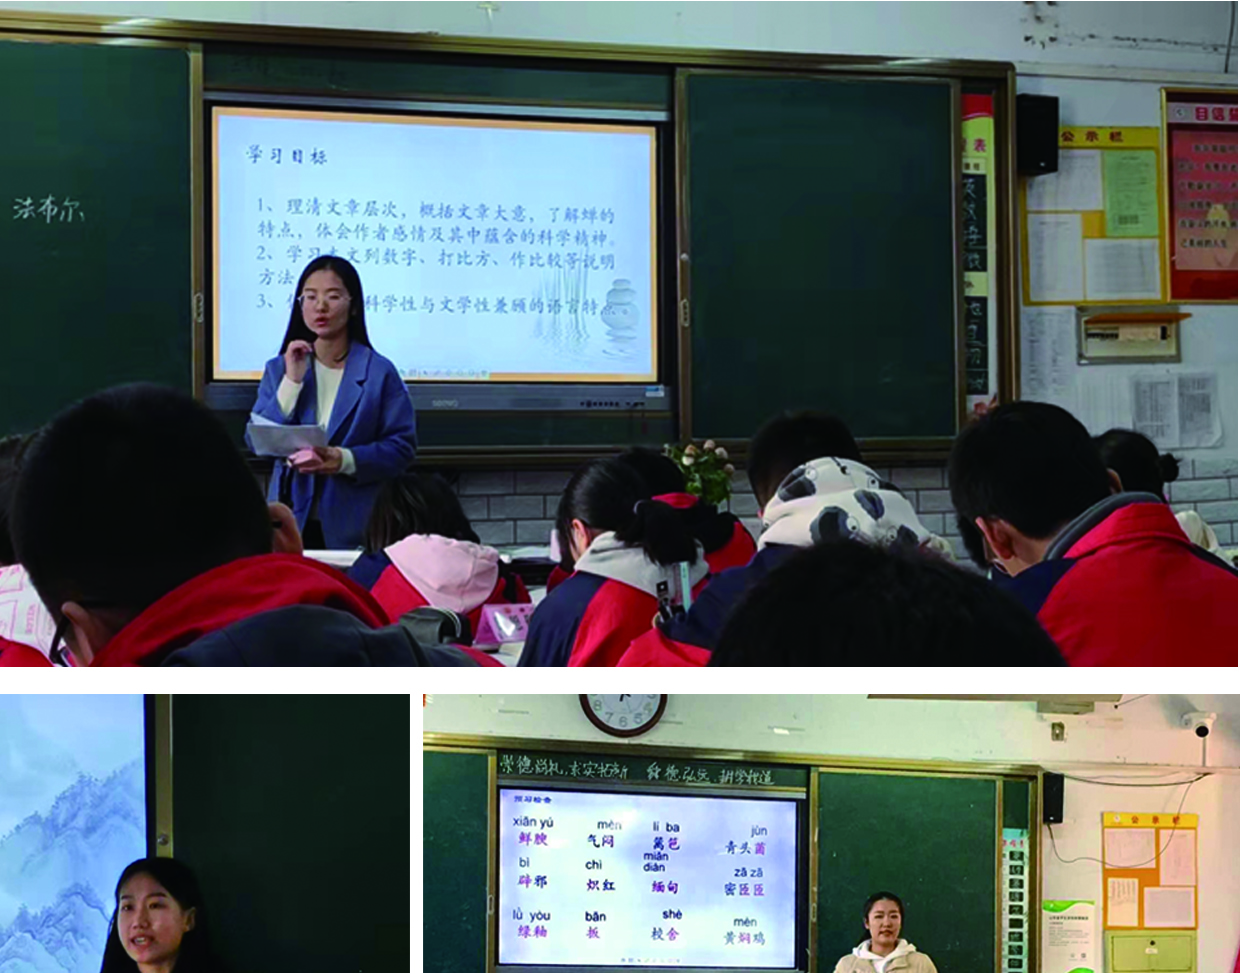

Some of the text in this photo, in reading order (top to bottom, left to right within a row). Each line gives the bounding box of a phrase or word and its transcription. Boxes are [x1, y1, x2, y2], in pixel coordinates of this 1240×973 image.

[1061, 130, 1124, 143] 公示栏
[247, 145, 328, 165] 学习目标
[13, 193, 85, 224] 法布尔
[588, 834, 614, 848] 气闷
[725, 840, 766, 856] 青头菌
[651, 927, 679, 941] 校舍
